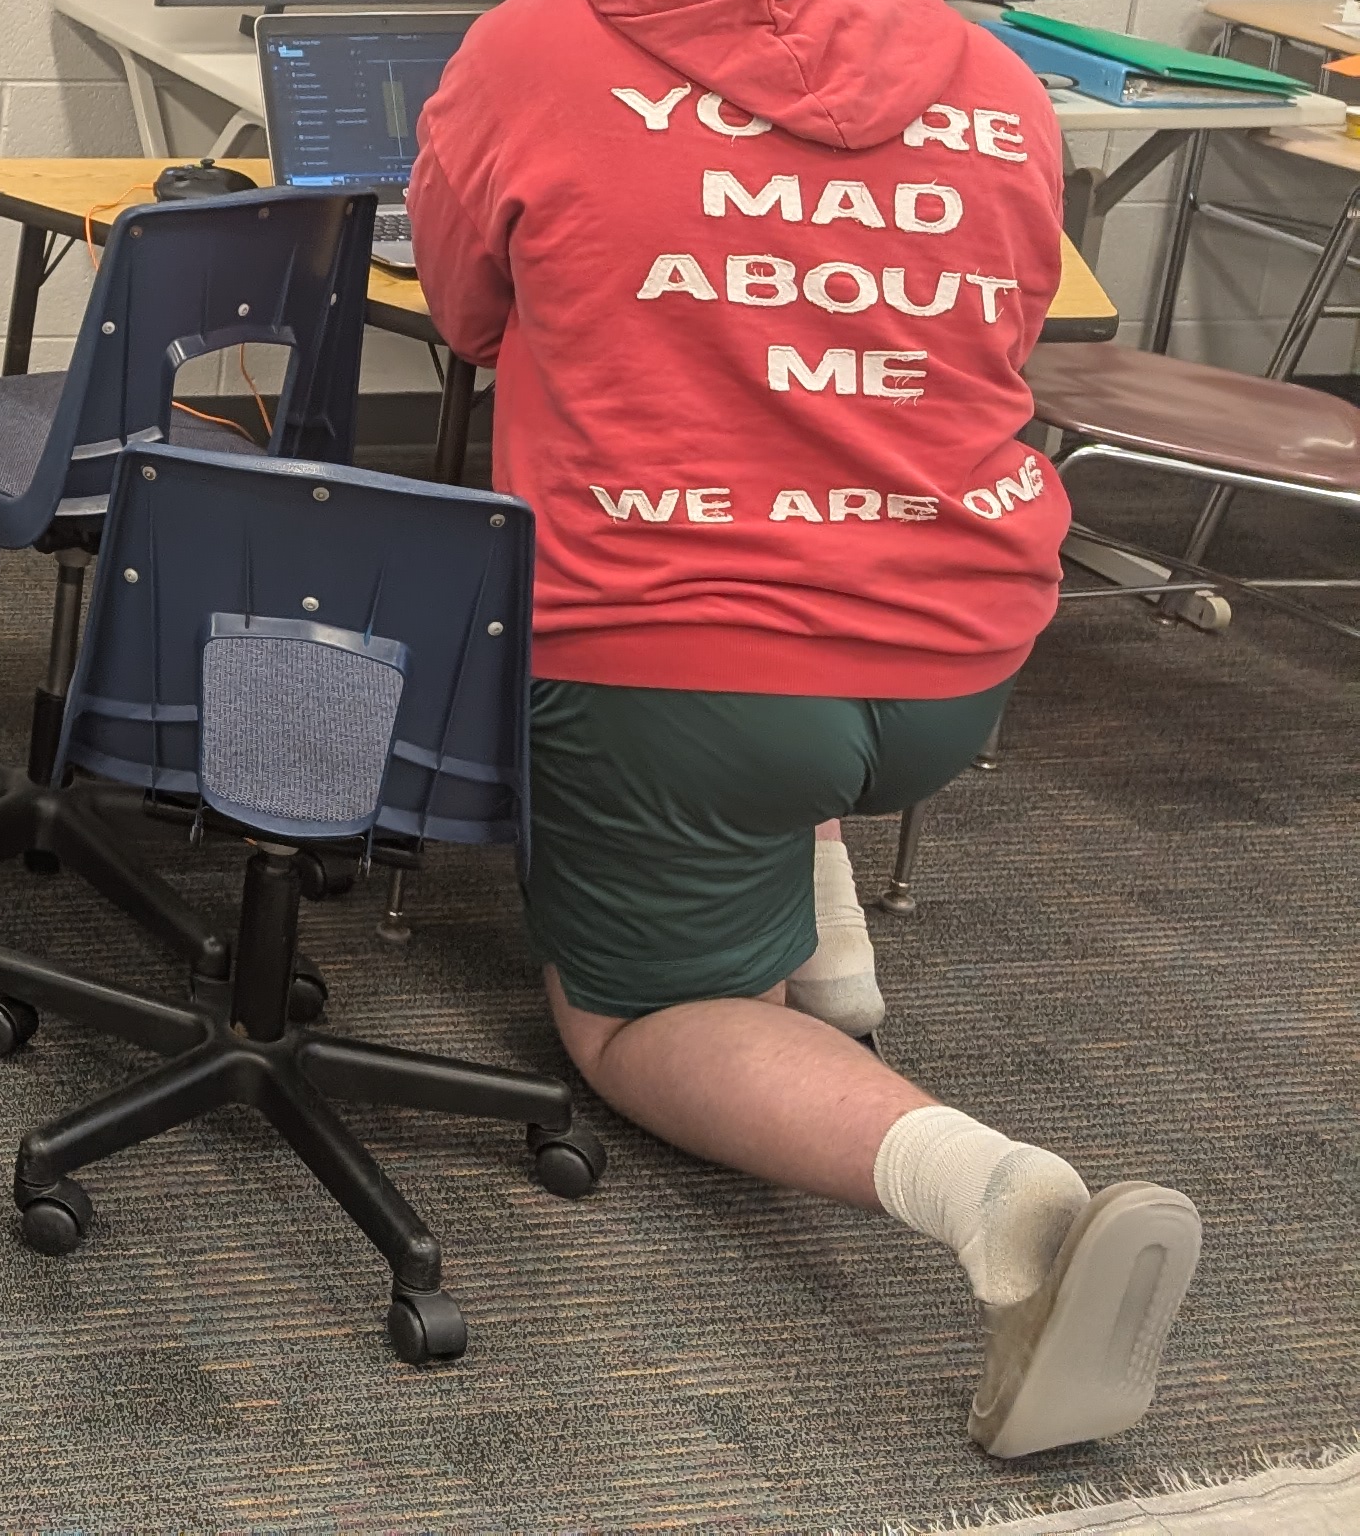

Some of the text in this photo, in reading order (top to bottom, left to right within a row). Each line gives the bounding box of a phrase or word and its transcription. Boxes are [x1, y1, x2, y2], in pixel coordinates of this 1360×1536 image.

[612, 83, 1027, 163] YO RE
[702, 170, 963, 233] MAD
[637, 254, 1018, 323] ABOUT
[768, 346, 928, 397] ME
[590, 456, 1045, 523] WE ARE ONE
